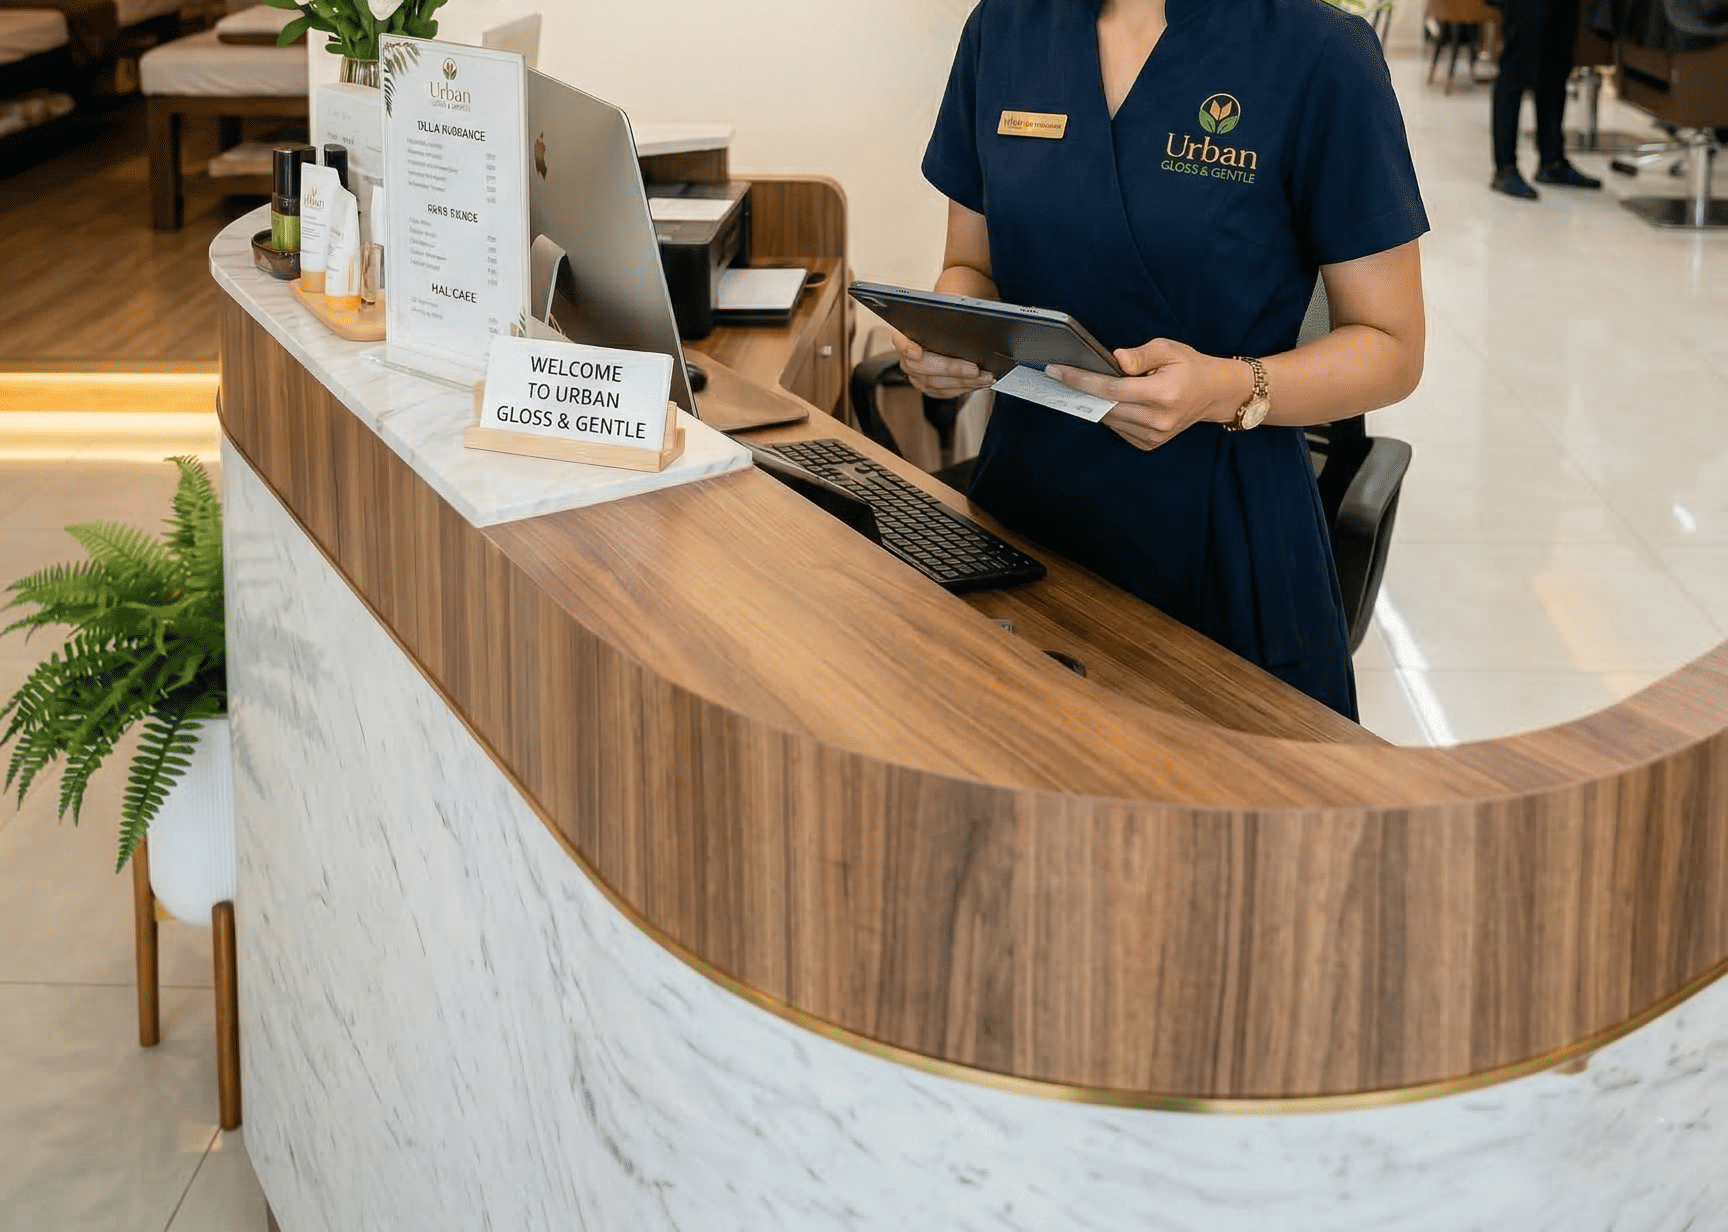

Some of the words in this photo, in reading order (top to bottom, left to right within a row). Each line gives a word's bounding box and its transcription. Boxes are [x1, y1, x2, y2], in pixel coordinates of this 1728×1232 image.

[430, 81, 471, 104] Urban
[1166, 132, 1257, 170] Urban
[1161, 160, 1199, 175] GLOSS
[1199, 166, 1209, 177] &
[1211, 167, 1256, 184] GENTLE
[530, 355, 624, 383] WELCOME
[528, 382, 550, 400] TO
[556, 386, 620, 409] URBAN
[496, 405, 553, 427] GLOSS
[557, 413, 570, 430] &
[575, 416, 647, 439] GENTLE
